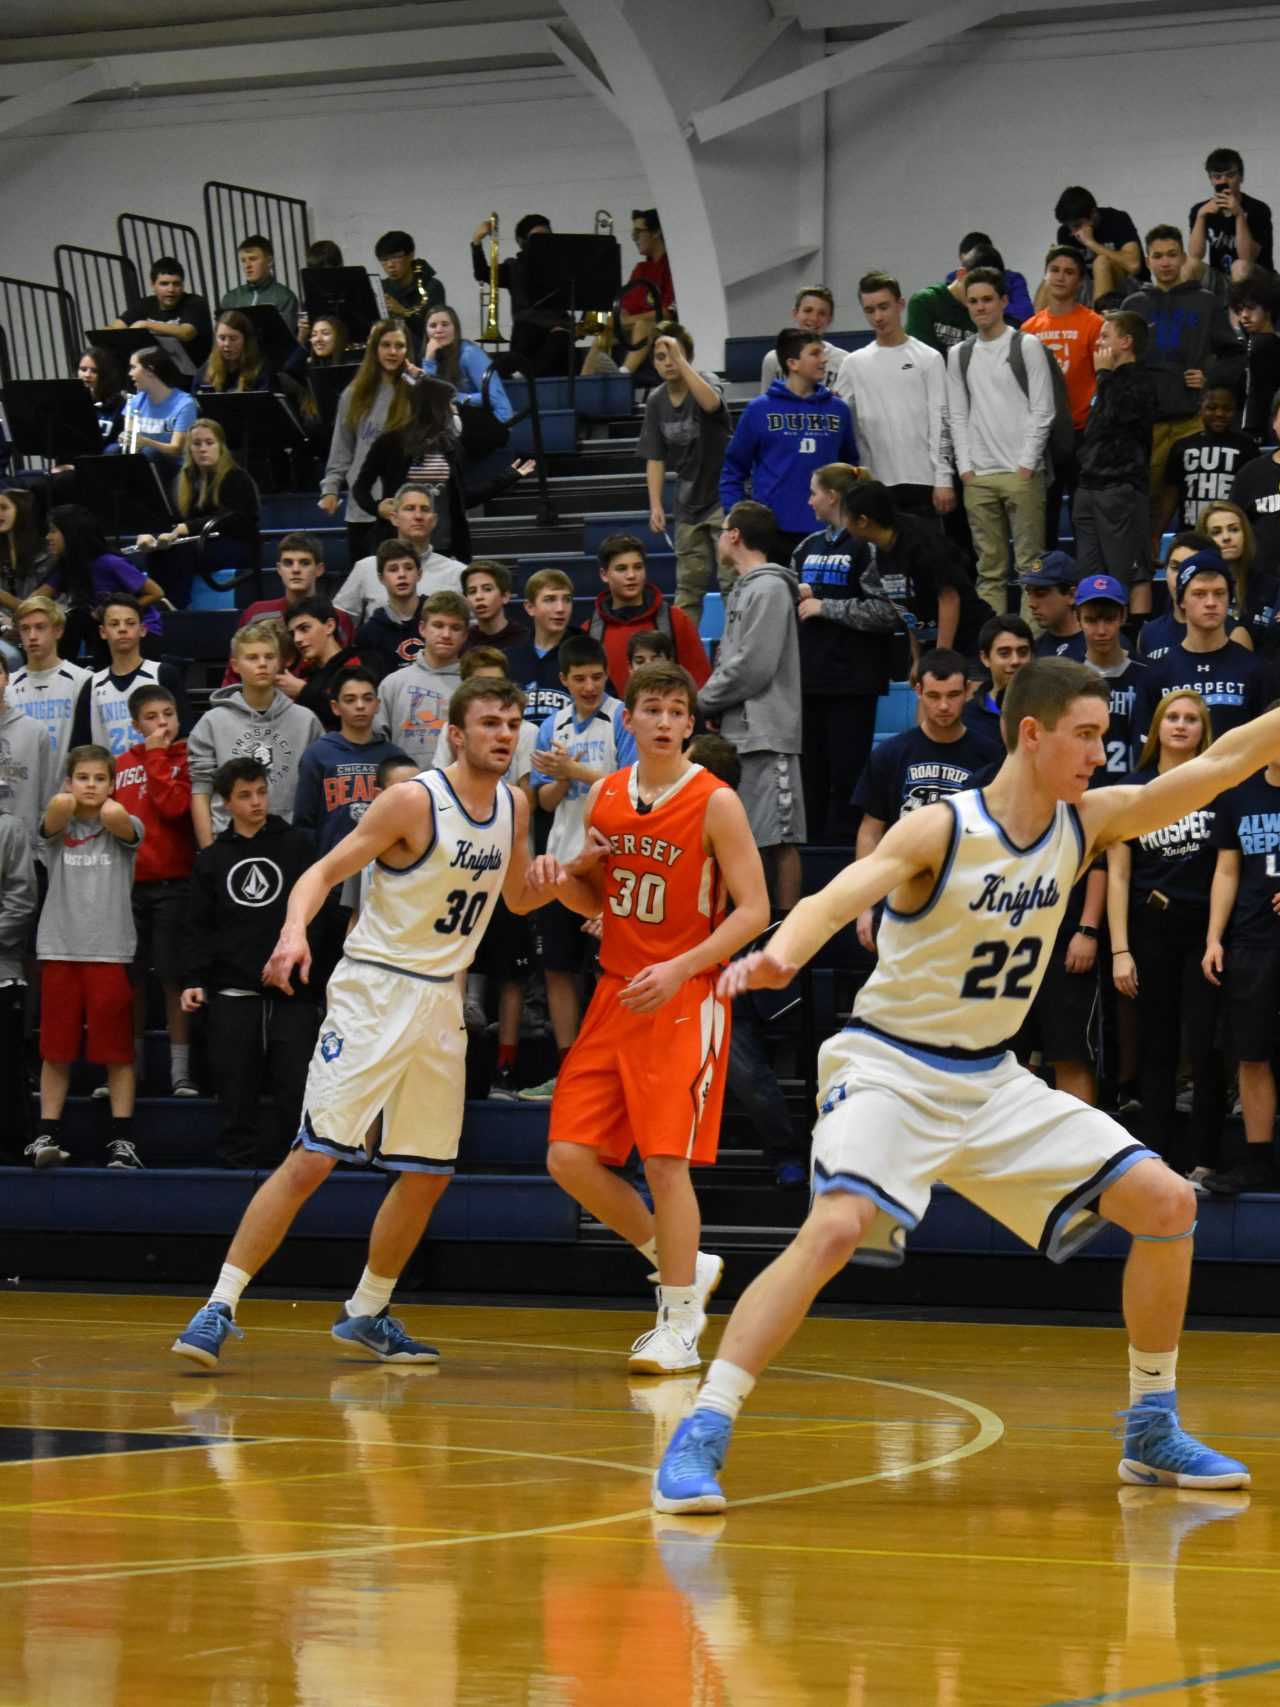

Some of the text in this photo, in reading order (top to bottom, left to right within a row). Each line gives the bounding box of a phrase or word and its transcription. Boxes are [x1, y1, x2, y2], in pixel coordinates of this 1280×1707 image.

[766, 412, 841, 433] DUKE
[1182, 446, 1240, 473] CUT
[1184, 472, 1236, 500] THE
[528, 690, 573, 711] SPECT
[336, 765, 377, 774] CHICAG
[909, 765, 969, 784] ROAD TRIP
[610, 834, 683, 867] ERSEY
[1161, 840, 1200, 858] Knights
[609, 867, 667, 925] 30
[968, 872, 1060, 928] Knights
[433, 888, 489, 937] 30
[959, 936, 1044, 1000] 22
